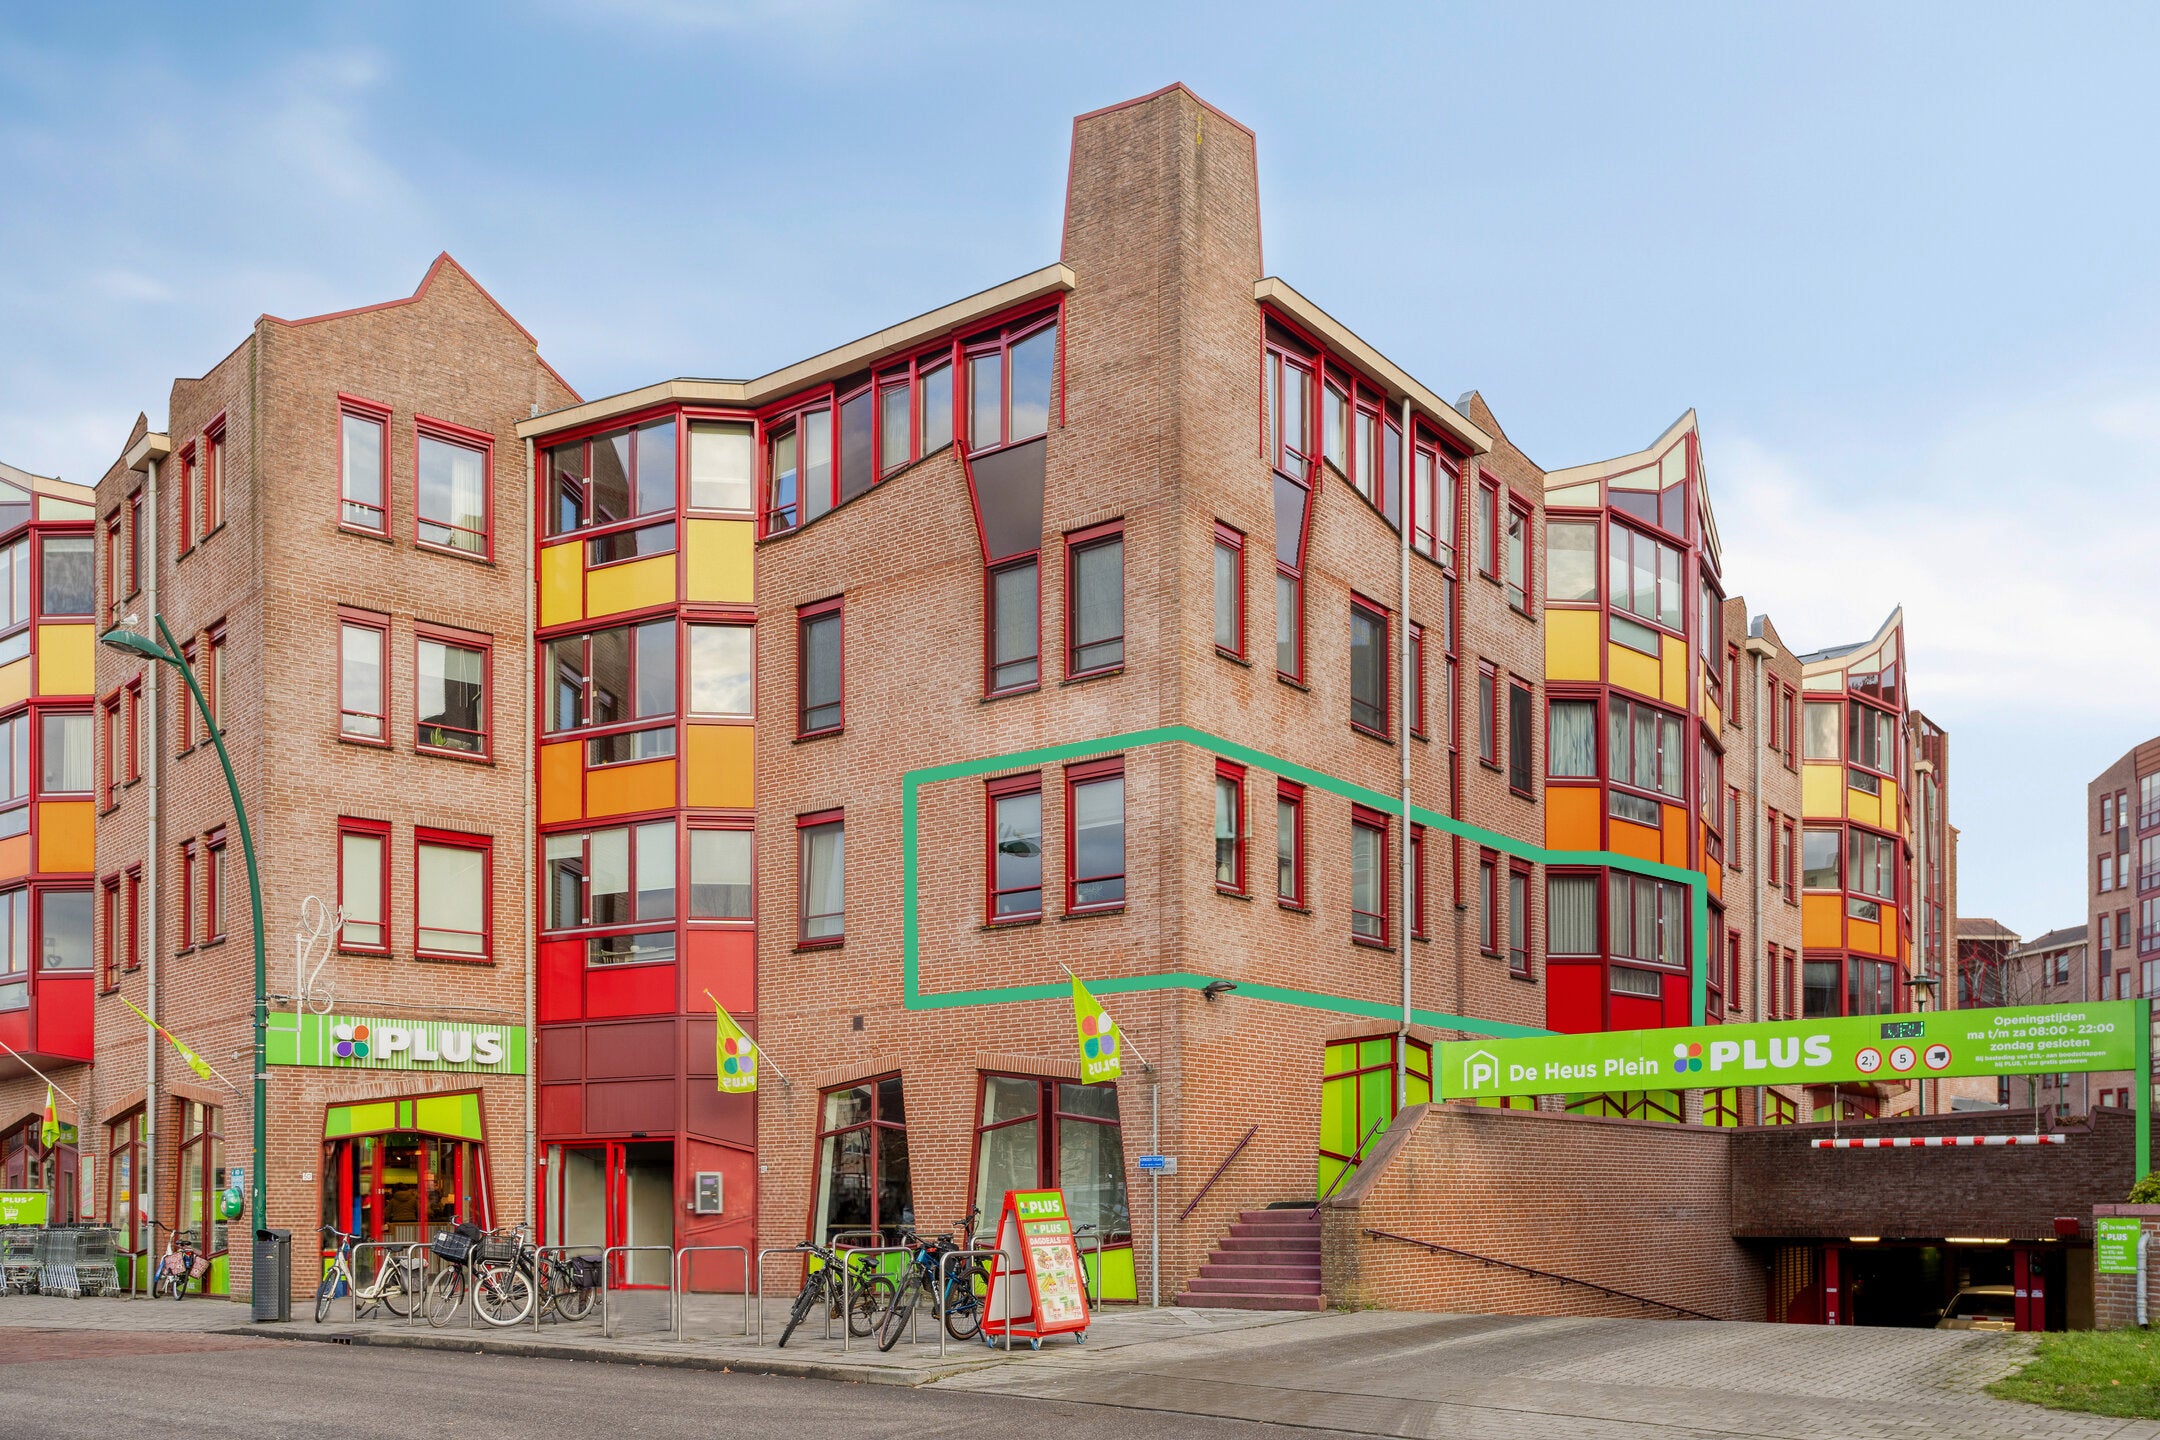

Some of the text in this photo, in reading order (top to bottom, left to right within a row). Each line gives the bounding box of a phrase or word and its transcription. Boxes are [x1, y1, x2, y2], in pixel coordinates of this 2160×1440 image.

[1994, 1013, 2086, 1027] Openingstijden
[1967, 1031, 1985, 1040] ma
[1988, 1028, 2009, 1040] t/m
[2012, 1029, 2026, 1038] za
[2028, 1025, 2068, 1037] 08:00
[2078, 1023, 2114, 1034] 22:00
[375, 1027, 504, 1064] PLUS
[1990, 1038, 2090, 1051] zondag gesloten
[1710, 1035, 1832, 1071] PLUS
[1899, 1053, 1907, 1064] 5
[1509, 1057, 1659, 1082] De Heus Plein
[2, 1196, 27, 1204] PLUS
[1029, 1200, 1060, 1214] PLUS
[1040, 1224, 1062, 1234] PLUS
[2107, 1233, 2128, 1241] PLUS
